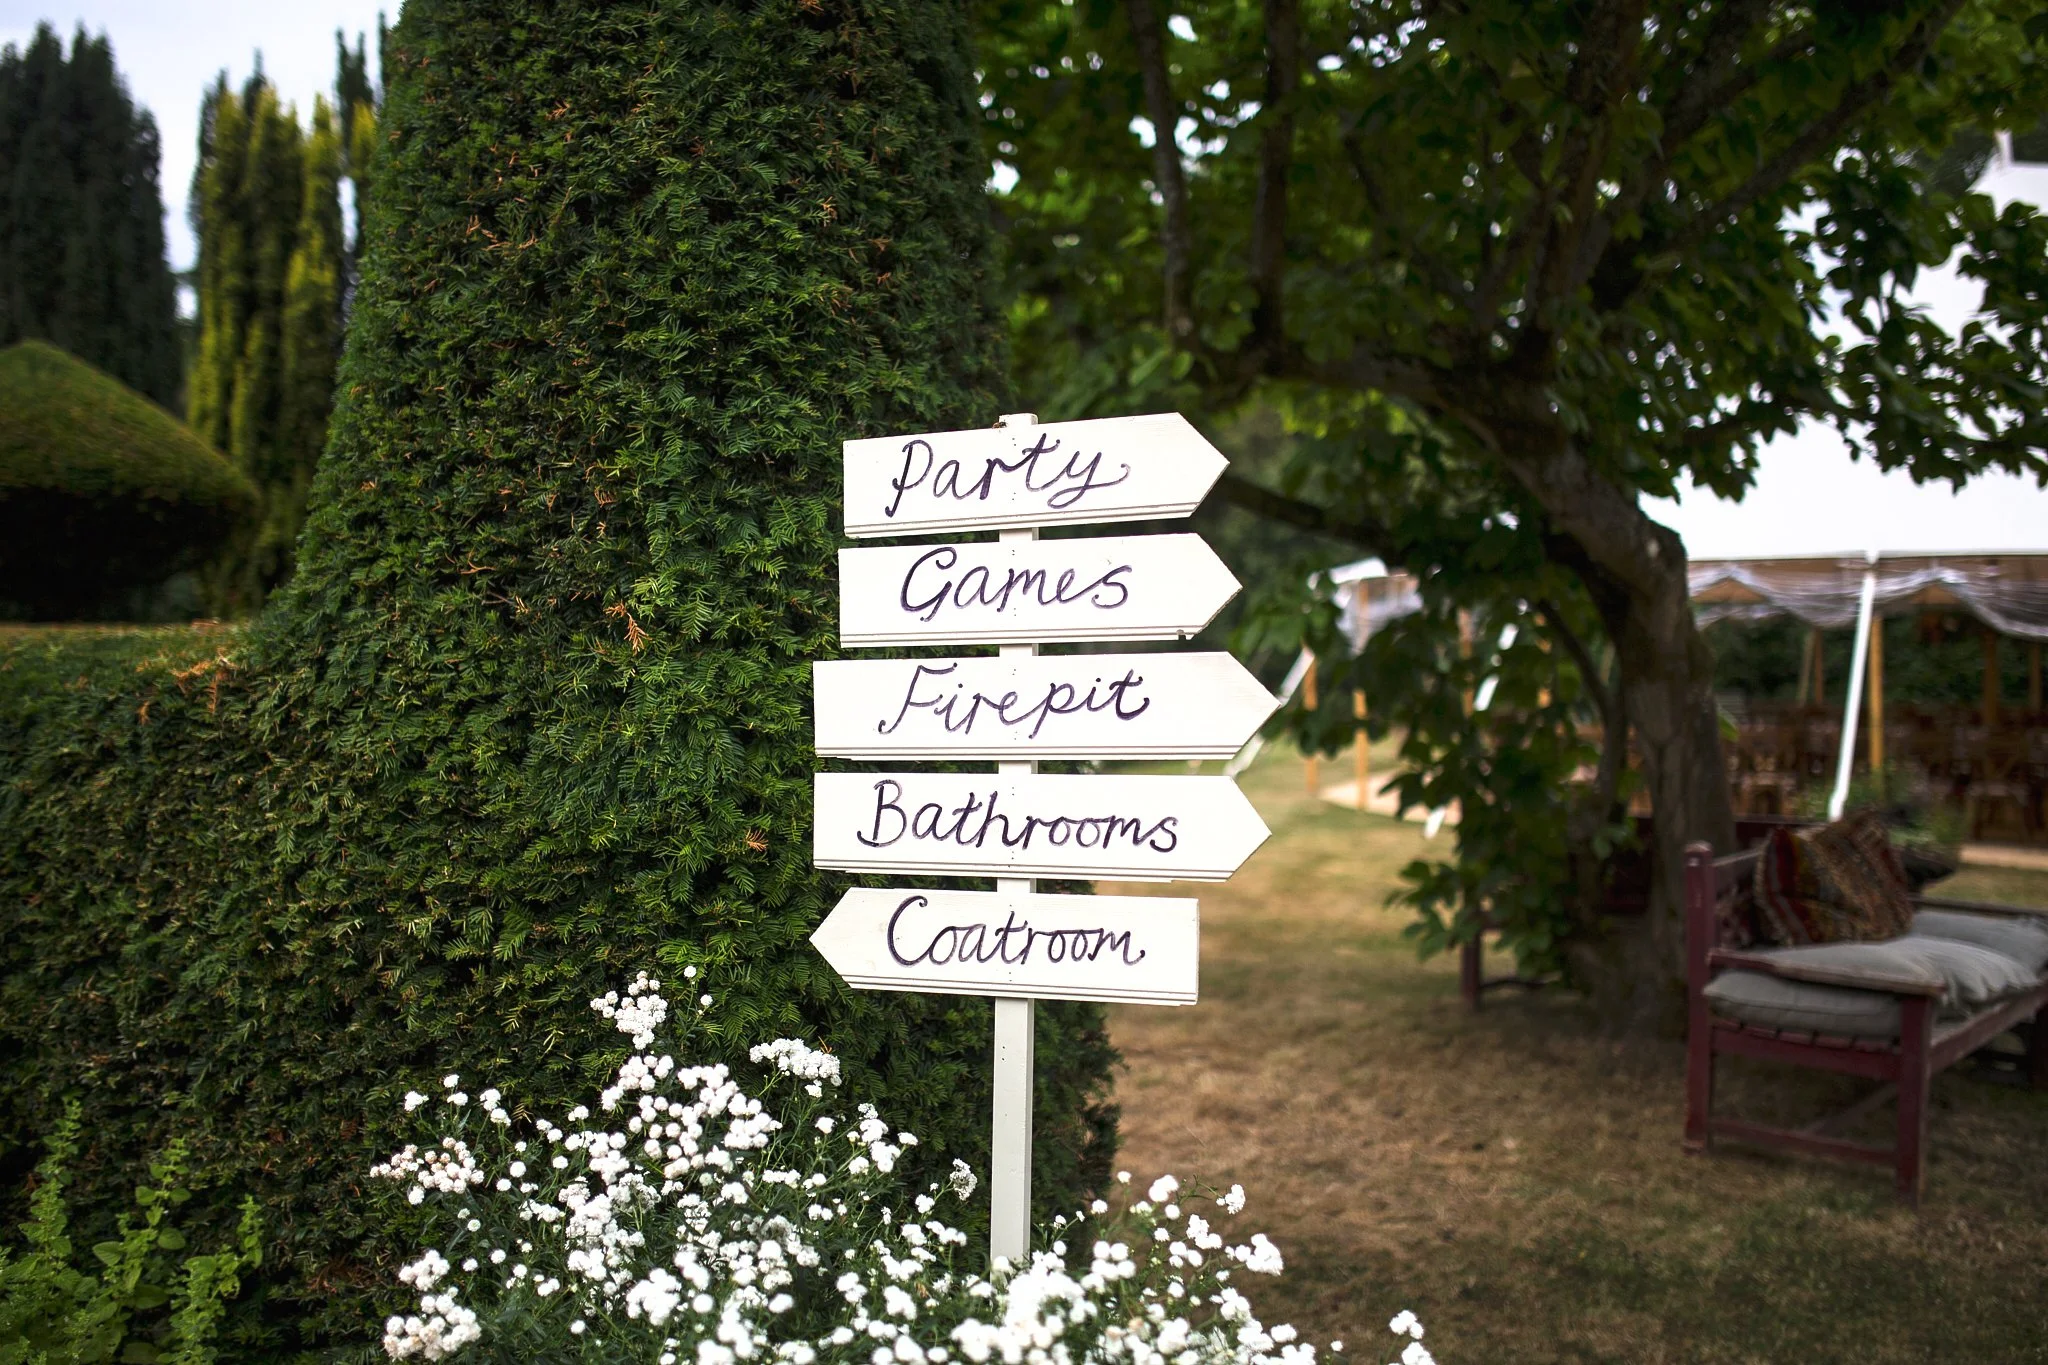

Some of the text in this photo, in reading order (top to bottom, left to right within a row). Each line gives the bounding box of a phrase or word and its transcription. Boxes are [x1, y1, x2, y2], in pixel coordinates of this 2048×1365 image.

[885, 433, 1131, 518] Party
[900, 546, 1133, 622] Games
[878, 662, 1150, 739] Firepit
[856, 779, 1178, 853] Bathrooms
[887, 895, 1146, 967] Coatroom
